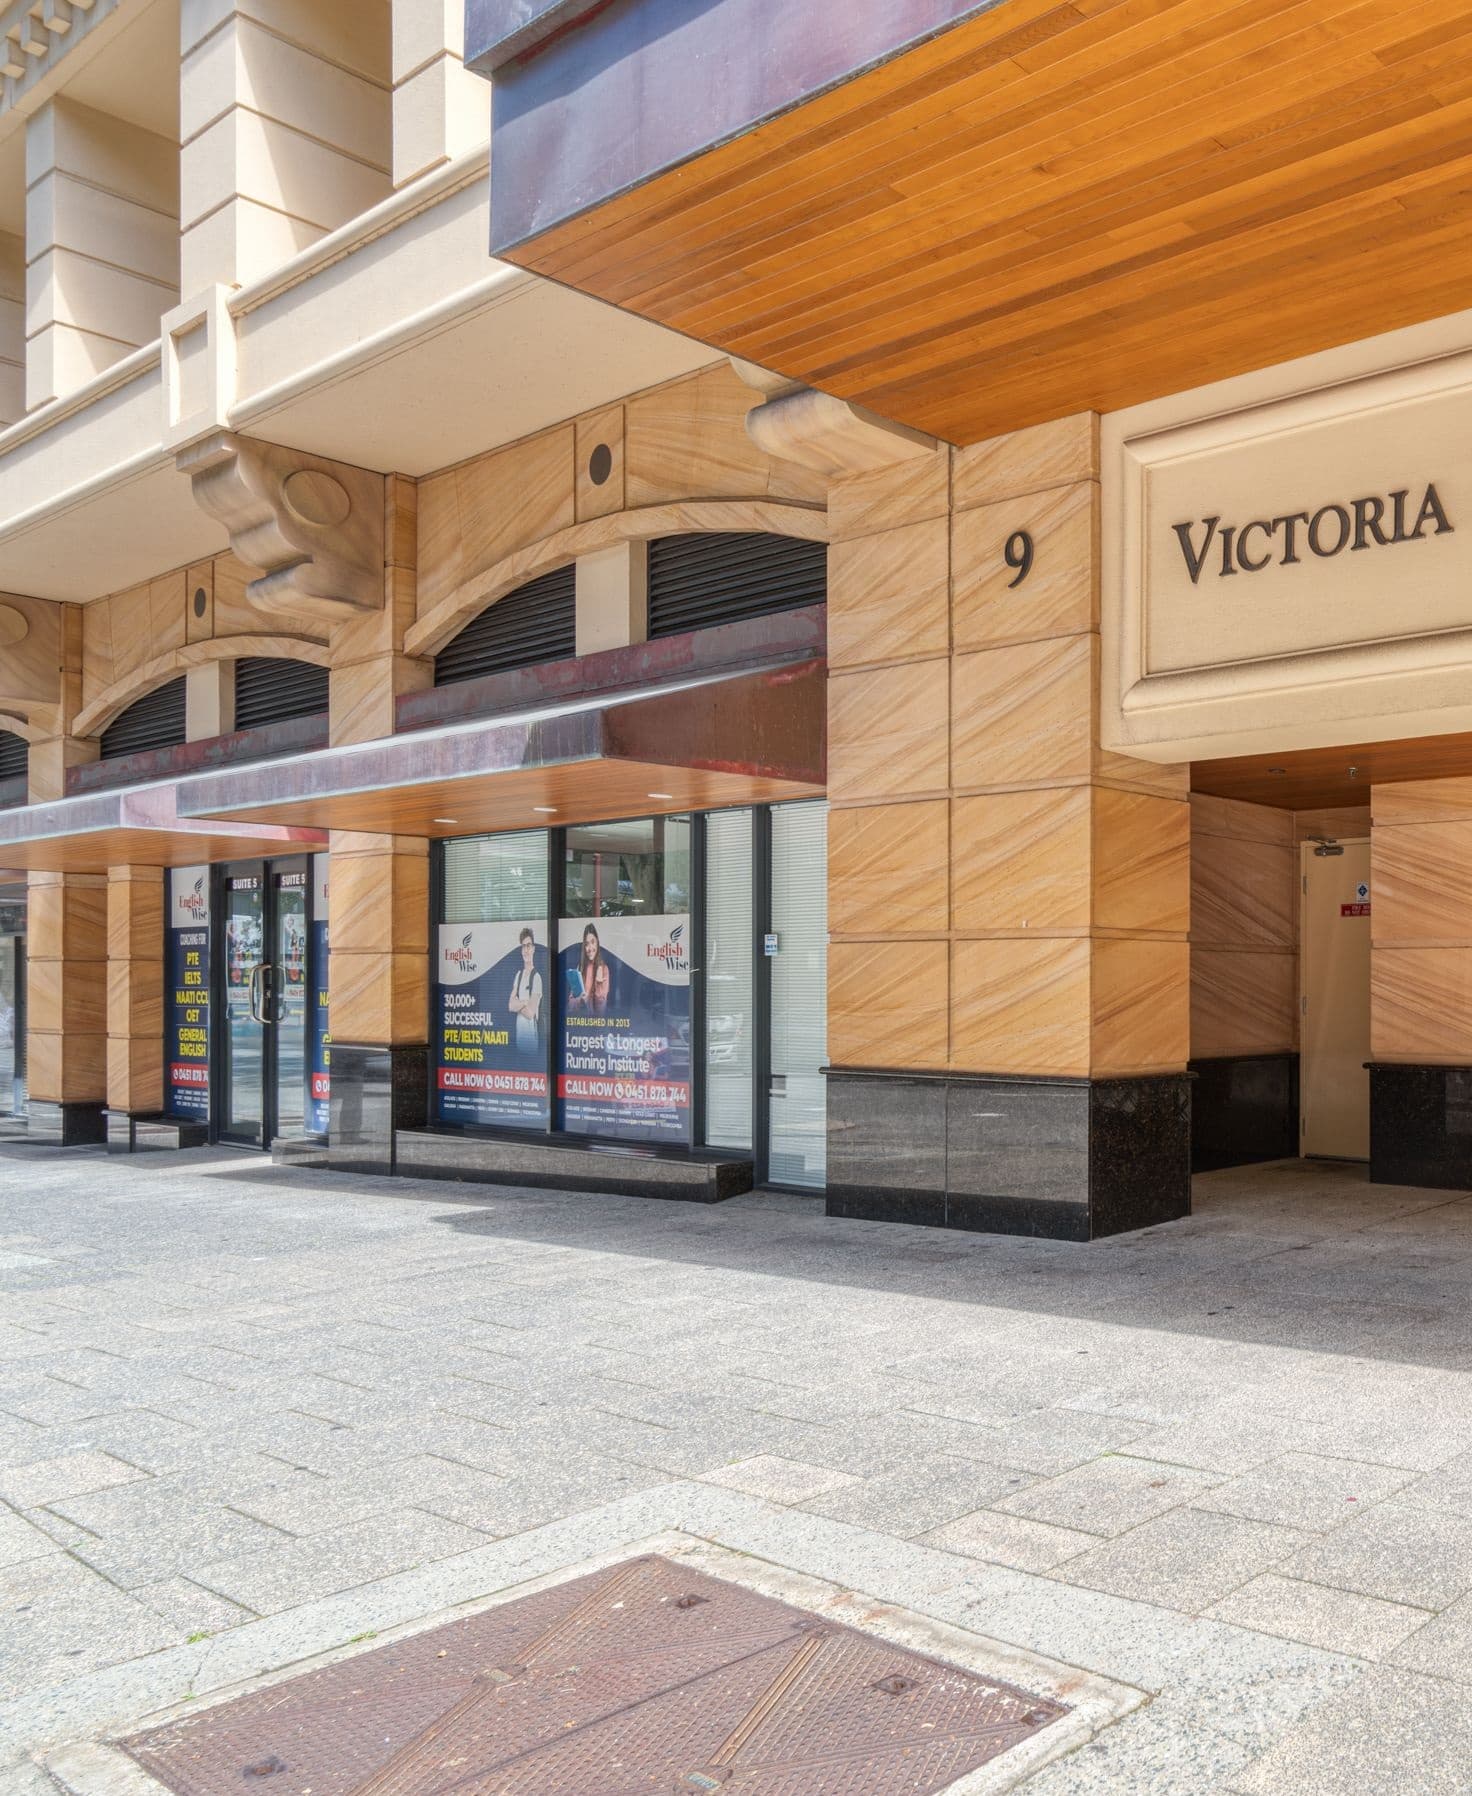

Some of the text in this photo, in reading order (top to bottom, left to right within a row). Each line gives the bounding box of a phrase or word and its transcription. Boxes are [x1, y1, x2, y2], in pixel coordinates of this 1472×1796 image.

[1172, 482, 1455, 585] VICTORIA
[1005, 530, 1035, 589] 9
[232, 878, 252, 889] SUITE
[281, 875, 298, 886] SUITE
[178, 893, 204, 912] English
[192, 907, 208, 920] Wise
[186, 952, 200, 966] PTE
[444, 947, 473, 964] English
[646, 942, 683, 961] English
[459, 960, 477, 973] Wise
[665, 957, 689, 970] Wise
[184, 971, 202, 985] IELTS
[176, 990, 195, 1005] NAATI
[444, 993, 476, 1009] 30,000+
[186, 1008, 200, 1022] OET
[444, 1011, 493, 1026] SUCCESSFUL
[566, 1017, 630, 1028] ESTABLISHED IN 2013
[178, 1028, 207, 1042] GENERAL
[179, 1043, 207, 1057] ENGLISH
[566, 1031, 661, 1056] Largest & Longest
[444, 1047, 484, 1062] STUDENTS
[566, 1052, 650, 1075] Running Institute
[444, 1072, 546, 1092] CALL NOW 0451 878 744
[565, 1079, 687, 1102] CALL NOW 0451 878 744
